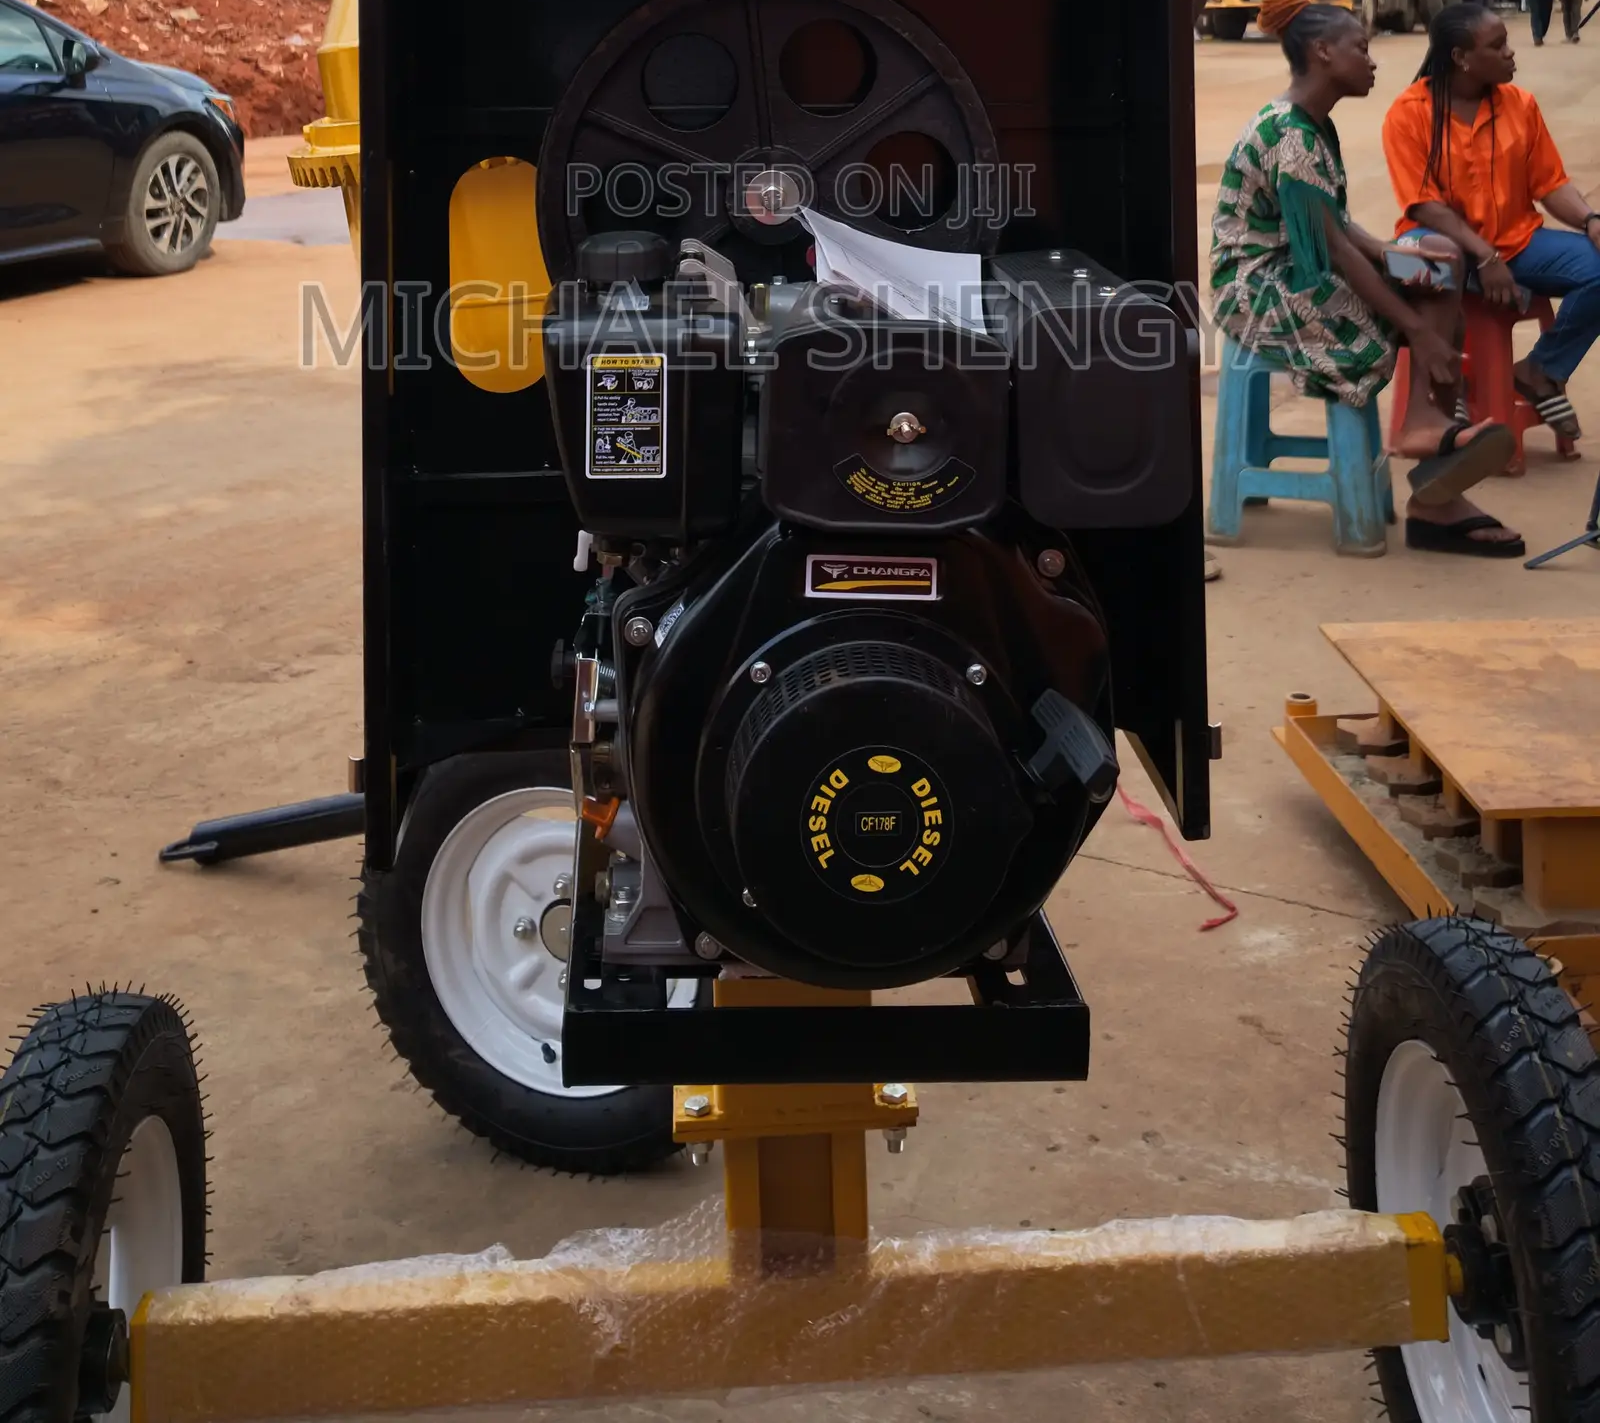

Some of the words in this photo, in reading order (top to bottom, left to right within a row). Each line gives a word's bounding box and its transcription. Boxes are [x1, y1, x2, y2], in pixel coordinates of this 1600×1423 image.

[853, 566, 930, 577] CHANGFA
[809, 768, 850, 869] DIESEL
[860, 816, 897, 831] CF178F
[899, 778, 943, 876] DIESEL
